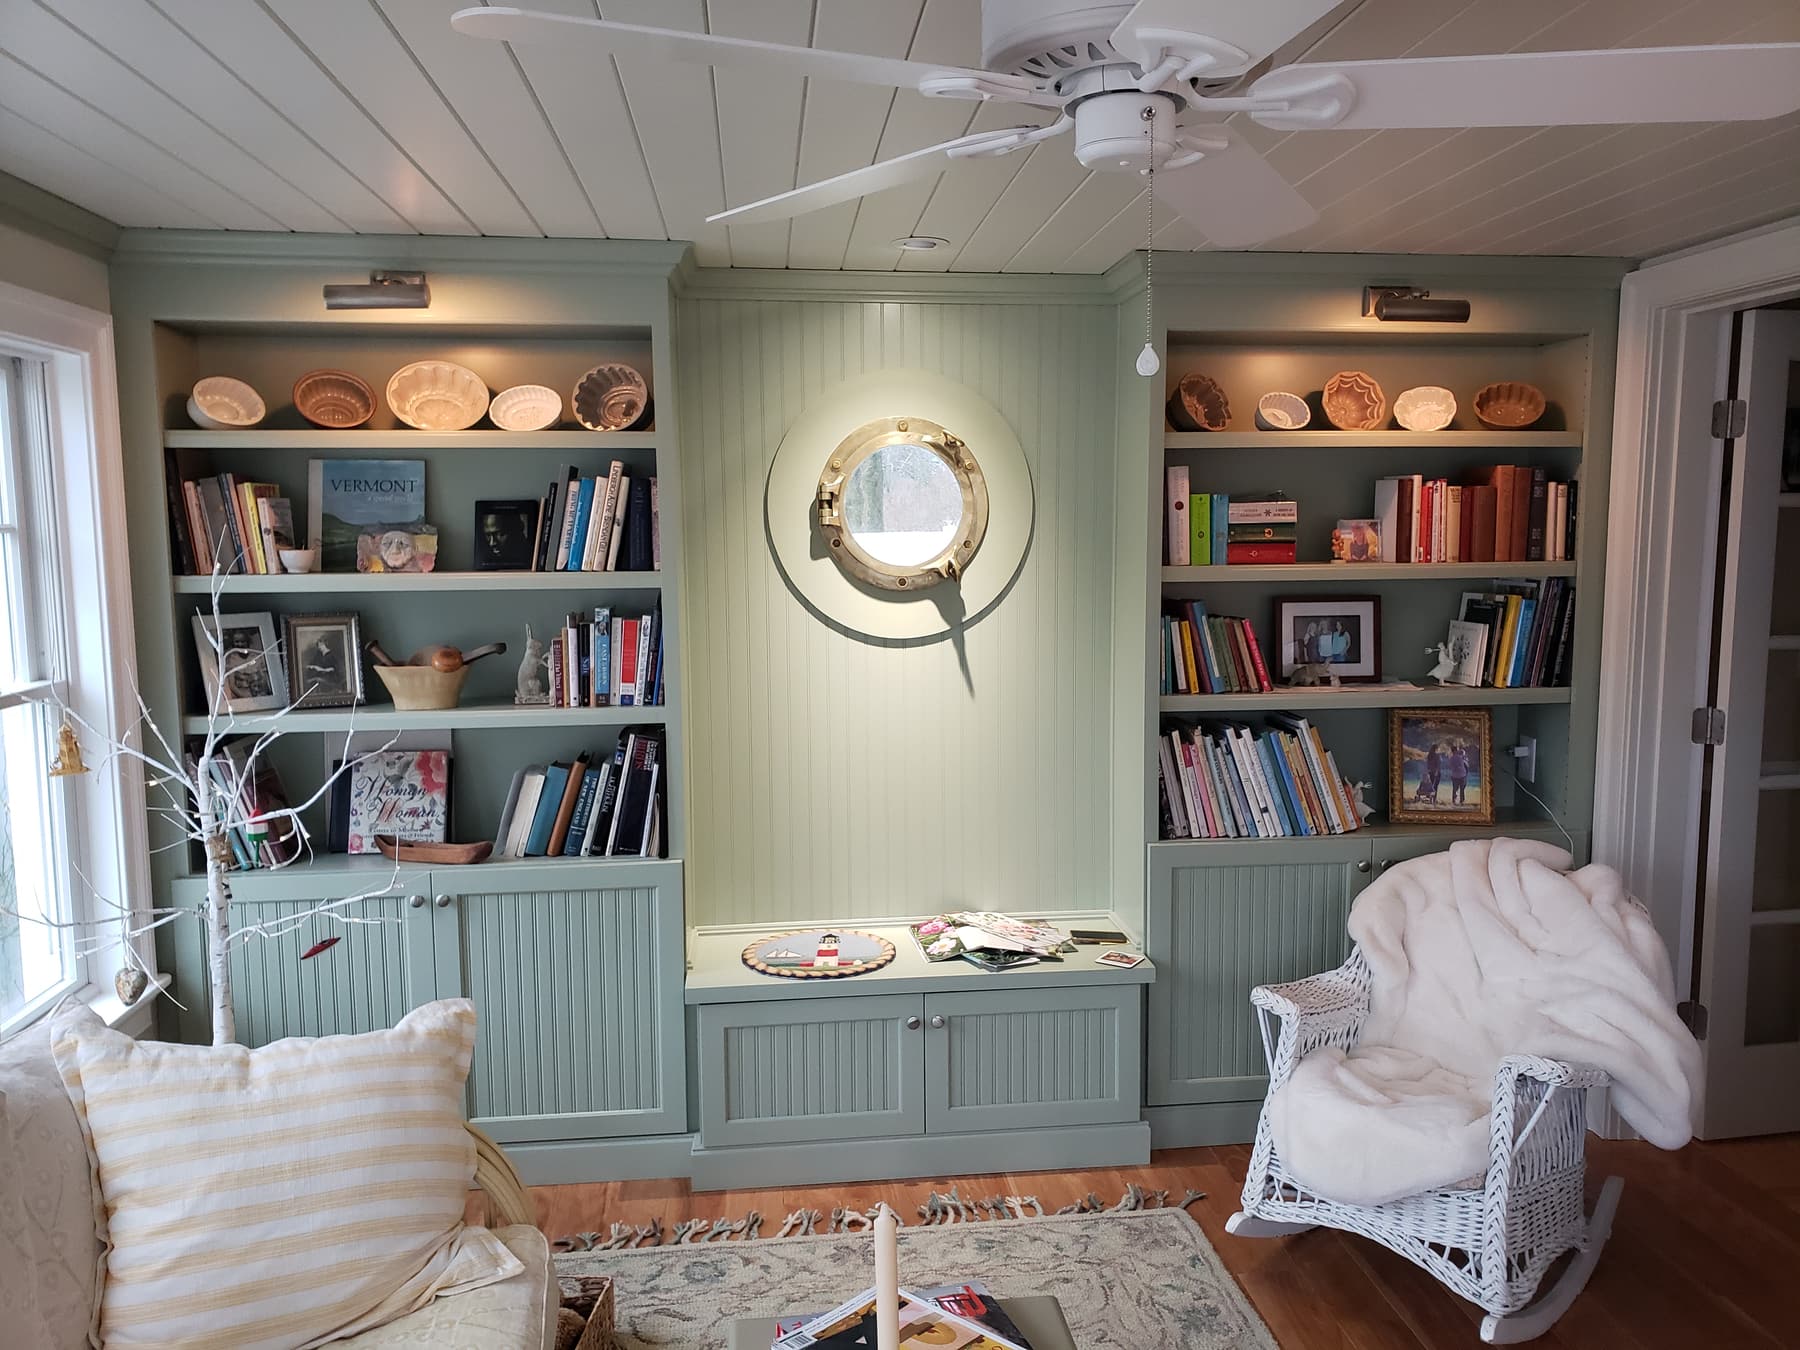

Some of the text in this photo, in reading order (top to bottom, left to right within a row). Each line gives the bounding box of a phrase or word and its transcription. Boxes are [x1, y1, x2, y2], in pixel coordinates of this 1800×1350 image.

[331, 479, 418, 493] VERMONT
[356, 774, 428, 802] Woman
[366, 797, 440, 823] Woman
